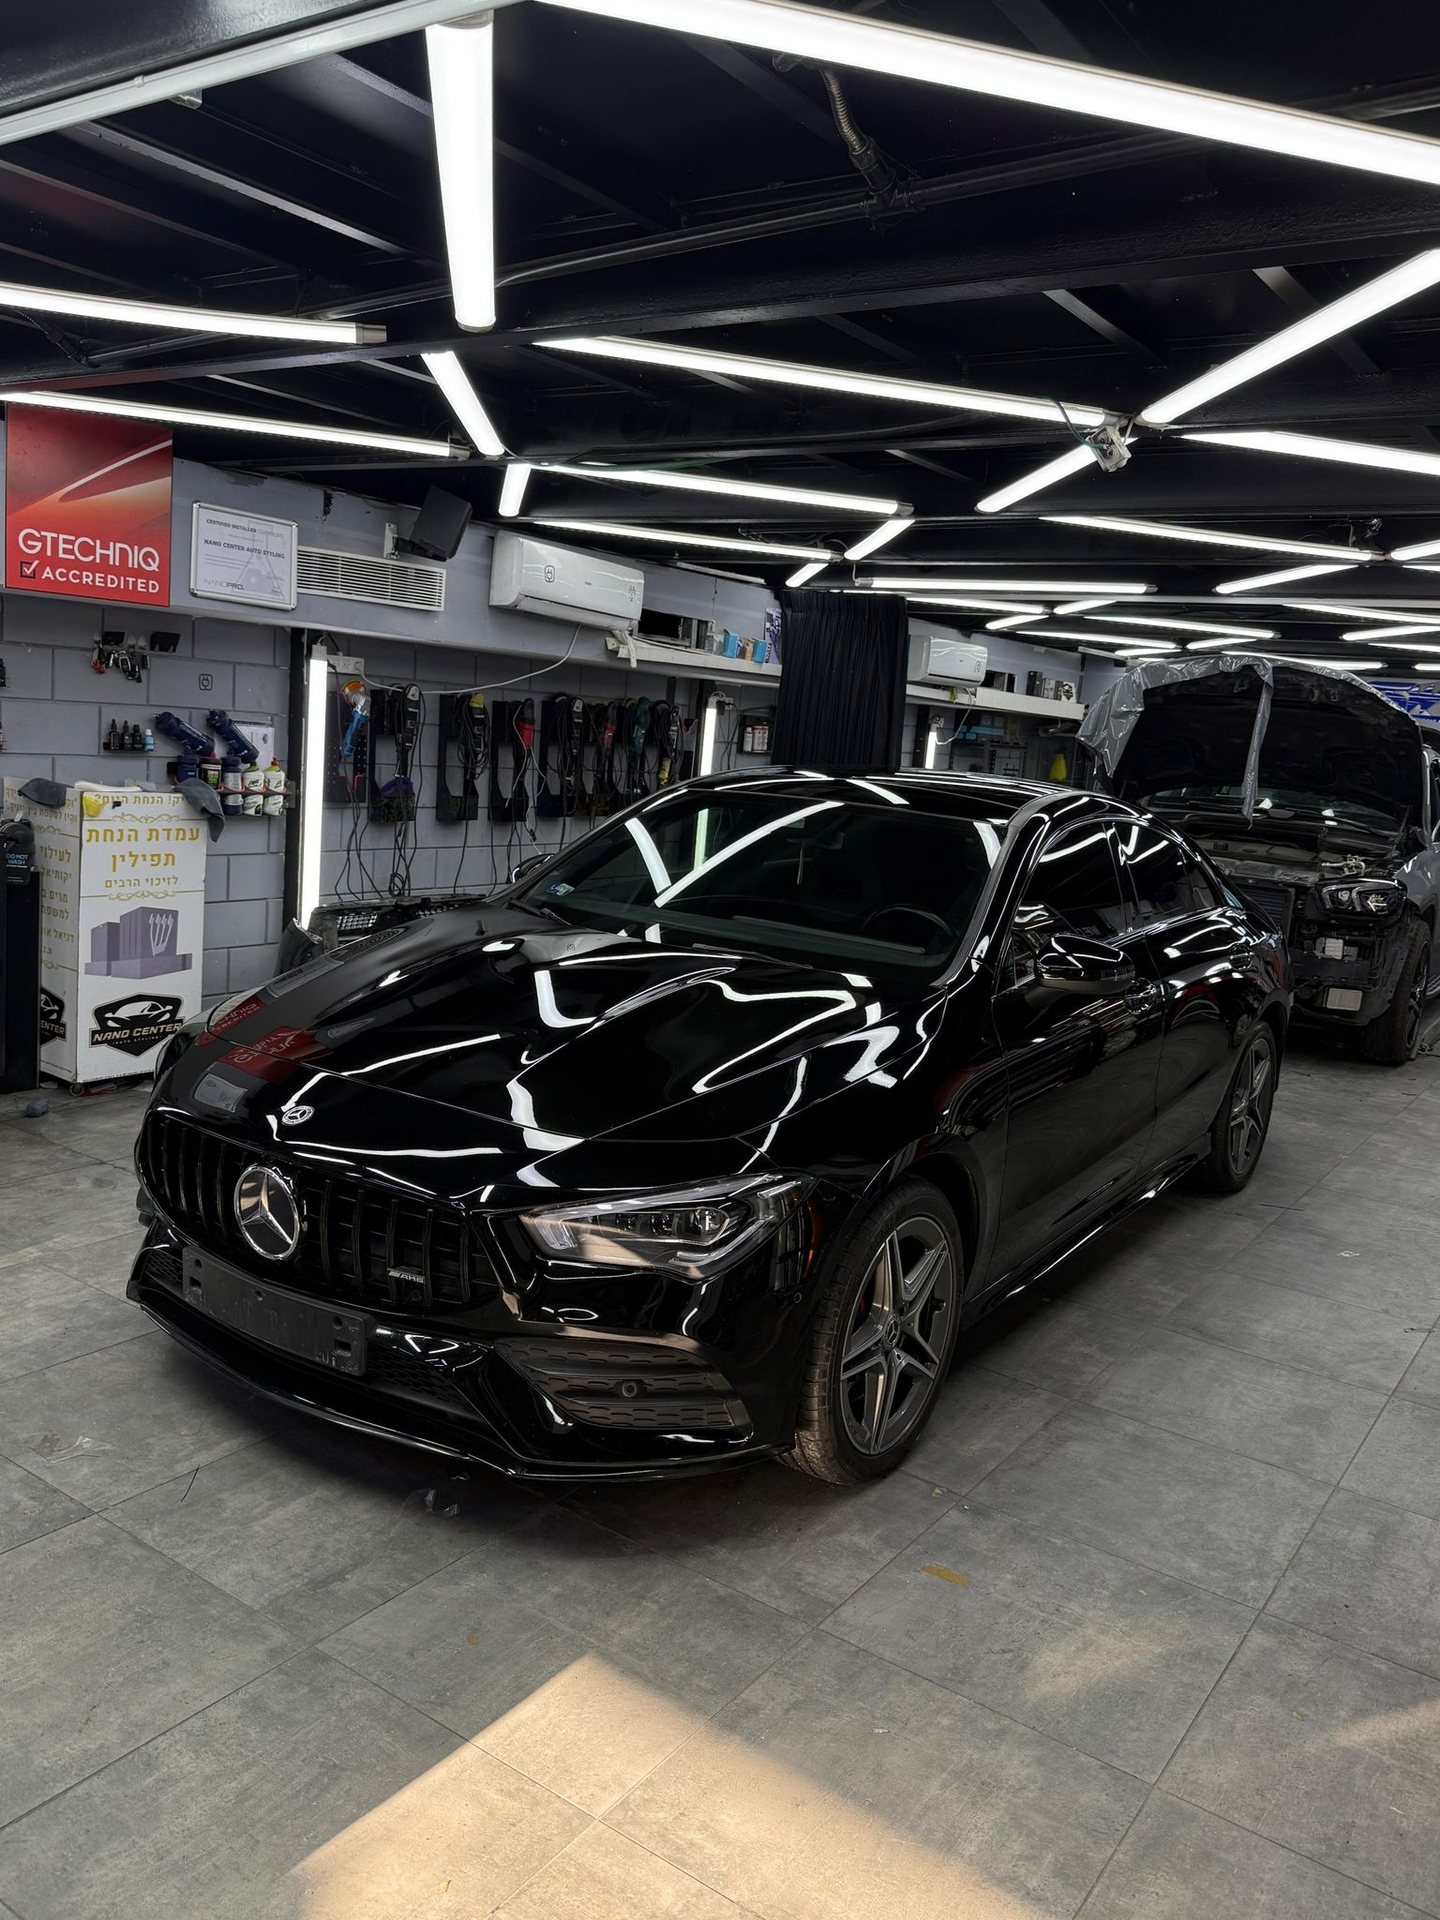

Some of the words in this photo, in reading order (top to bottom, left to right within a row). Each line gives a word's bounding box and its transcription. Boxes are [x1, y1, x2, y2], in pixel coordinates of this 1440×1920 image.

[206, 518, 231, 528] CERTIFIED
[231, 524, 257, 533] INSTALLER
[18, 528, 160, 572] GTECHNIQ
[204, 539, 222, 547] NANO
[223, 542, 245, 551] CENTER
[246, 547, 262, 555] AUTO
[263, 550, 286, 559] STYLING
[42, 566, 160, 594] ACCREDITED
[133, 795, 164, 805] הנחת
[86, 828, 139, 843] הנחת
[147, 827, 200, 842] עמדת
[112, 851, 176, 872] תפילין
[105, 878, 140, 888] הרבים
[146, 875, 179, 887] לזיכוי
[40, 1020, 66, 1036] ENTER
[92, 1029, 130, 1042] NANO
[132, 1022, 182, 1036] CENTER
